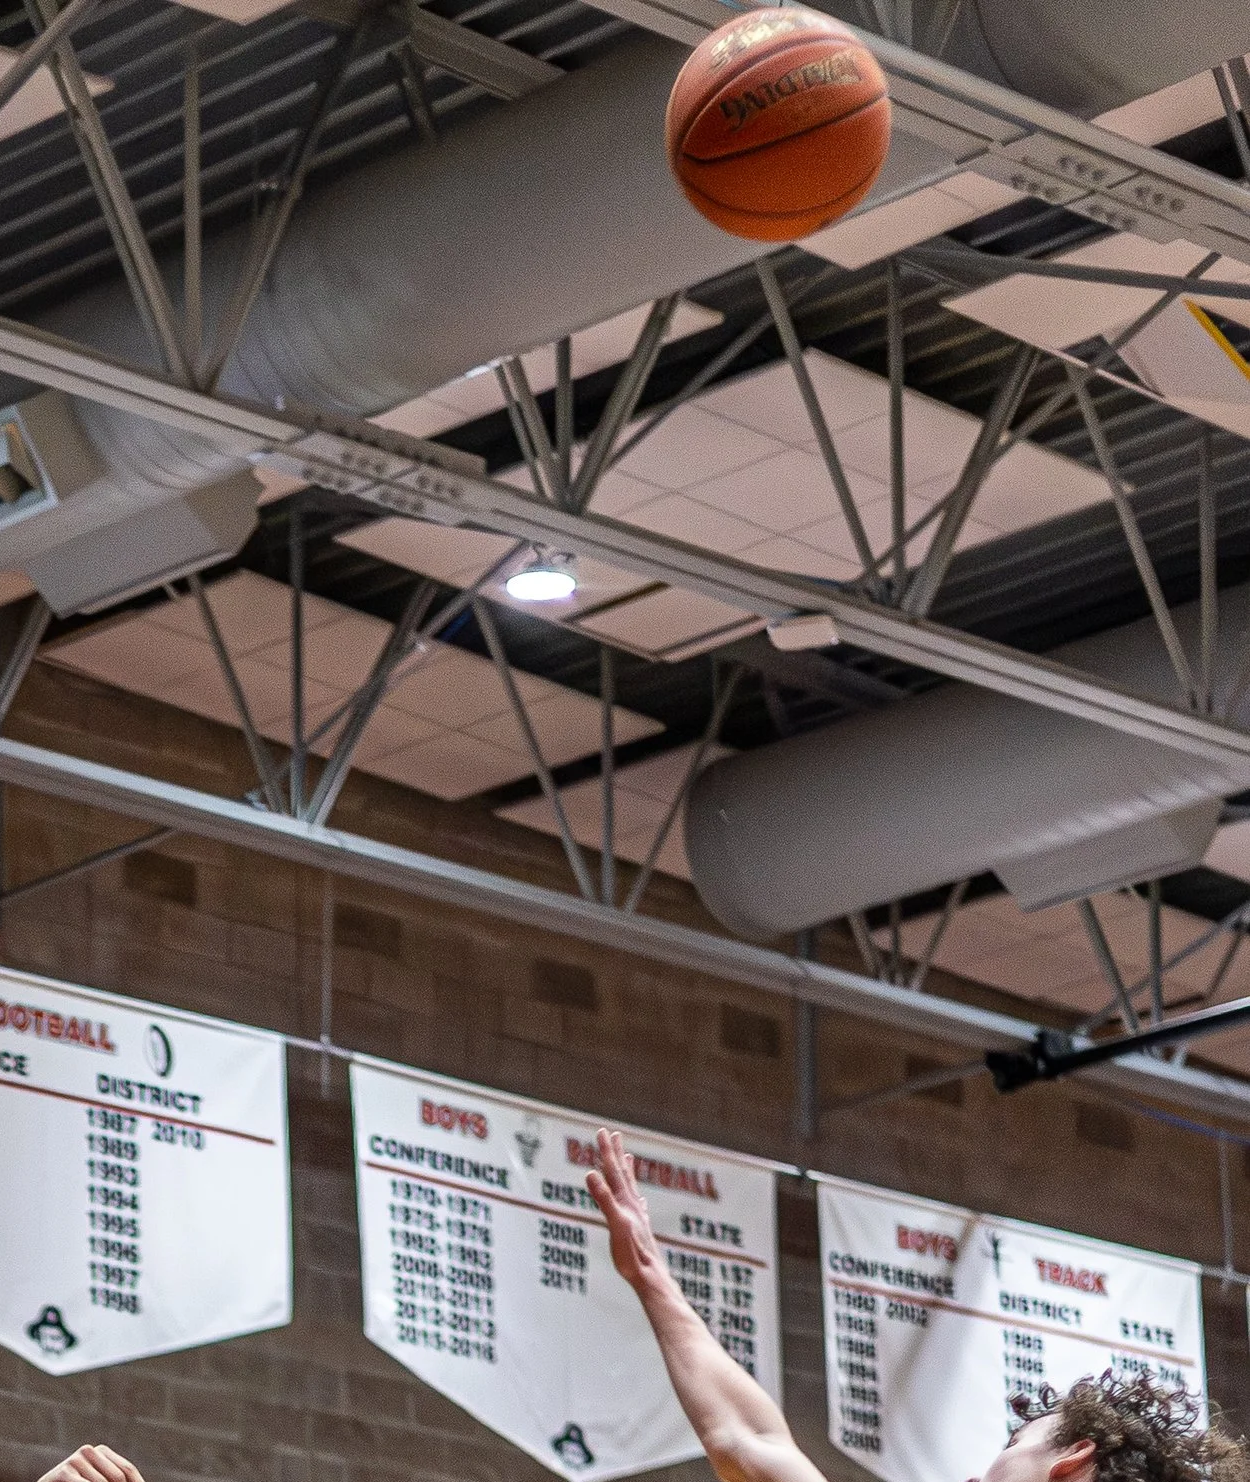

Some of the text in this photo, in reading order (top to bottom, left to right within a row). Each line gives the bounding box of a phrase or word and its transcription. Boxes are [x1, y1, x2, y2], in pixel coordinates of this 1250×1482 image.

[96, 1073, 202, 1114] DISTRICT
[418, 1097, 489, 1141] BOYS
[368, 1134, 512, 1190] CONFERENCE
[679, 1213, 743, 1247] STATE
[1033, 1256, 1108, 1297] TRACK
[998, 1290, 1082, 1325] DISTRICT
[1119, 1318, 1174, 1349] STATE
